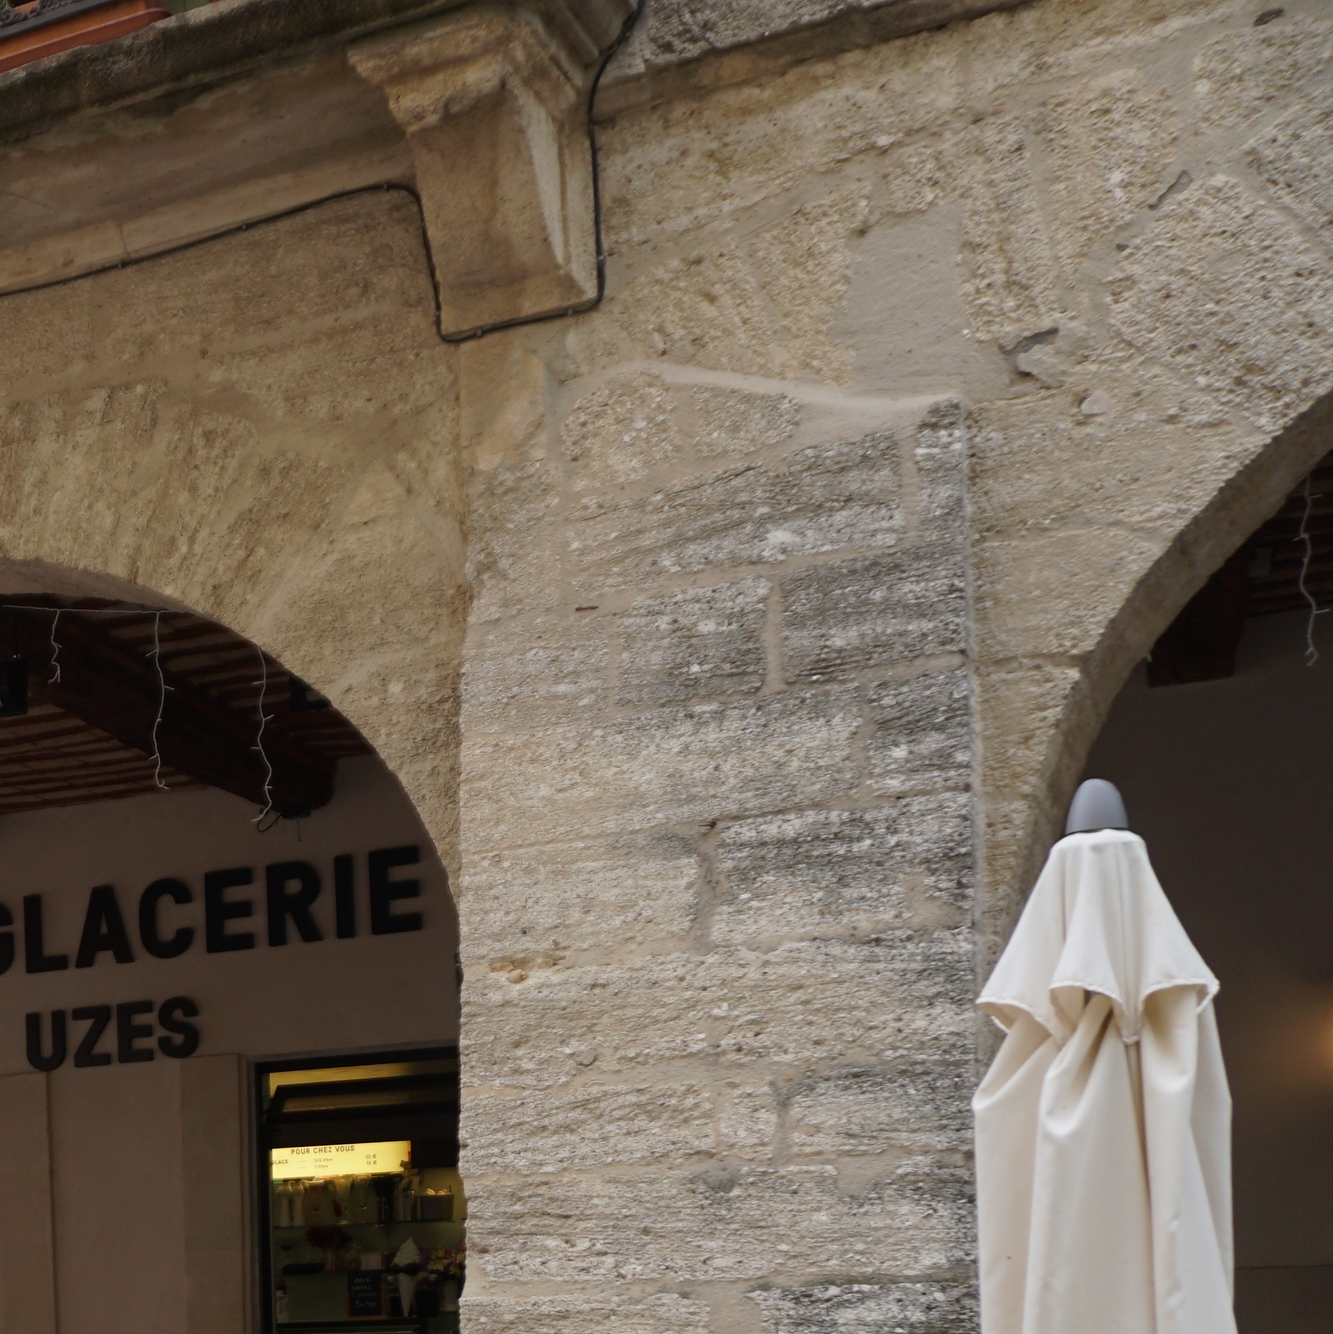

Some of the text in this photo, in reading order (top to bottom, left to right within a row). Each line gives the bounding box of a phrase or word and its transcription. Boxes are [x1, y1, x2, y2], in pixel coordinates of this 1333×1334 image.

[25, 995, 201, 1072] UZES
[290, 1145, 355, 1155] POUR CHEZ VOUS
